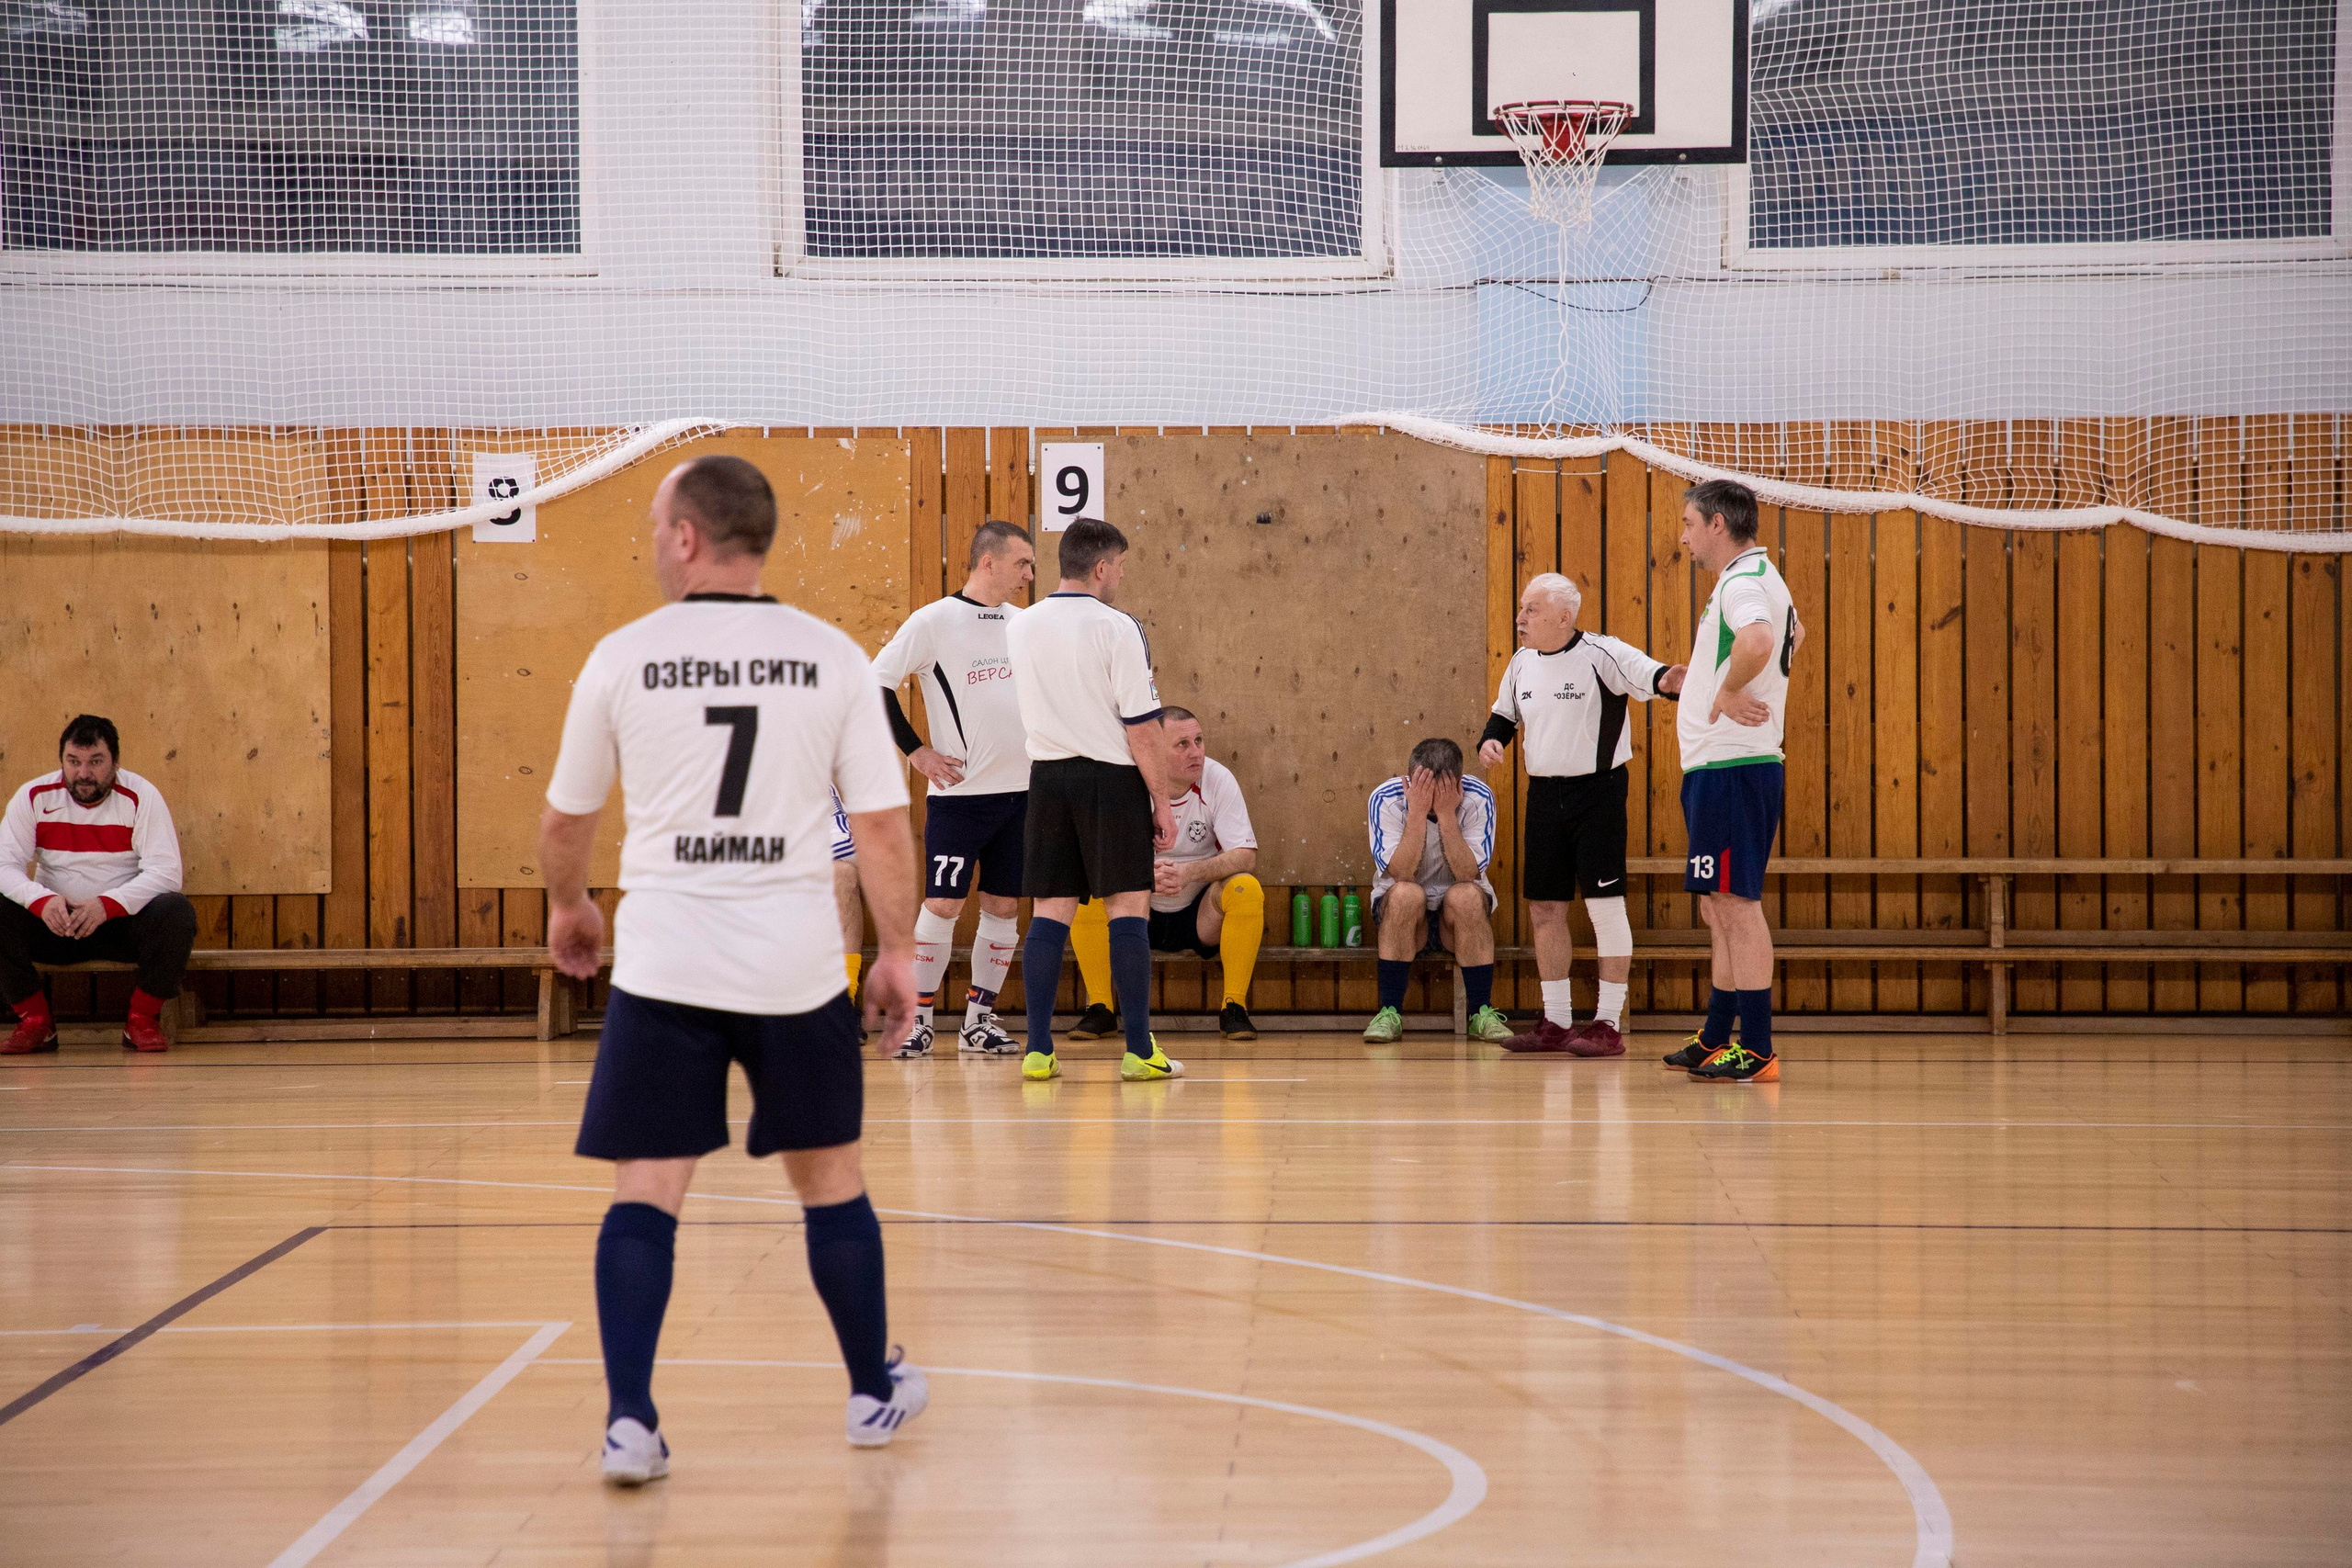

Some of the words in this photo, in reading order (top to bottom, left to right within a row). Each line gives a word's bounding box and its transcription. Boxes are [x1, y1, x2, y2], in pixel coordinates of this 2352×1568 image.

[1056, 466, 1089, 514] 9
[644, 656, 741, 689] ОЗЁРЫ
[749, 660, 818, 688] СИТИ
[972, 658, 999, 668] САЛОН
[1564, 682, 1575, 691] ДС
[705, 705, 759, 818] 7
[674, 830, 786, 863] КАЙМАН
[933, 855, 965, 887] 77
[1690, 854, 1714, 879] 13
[915, 954, 933, 963] CSM
